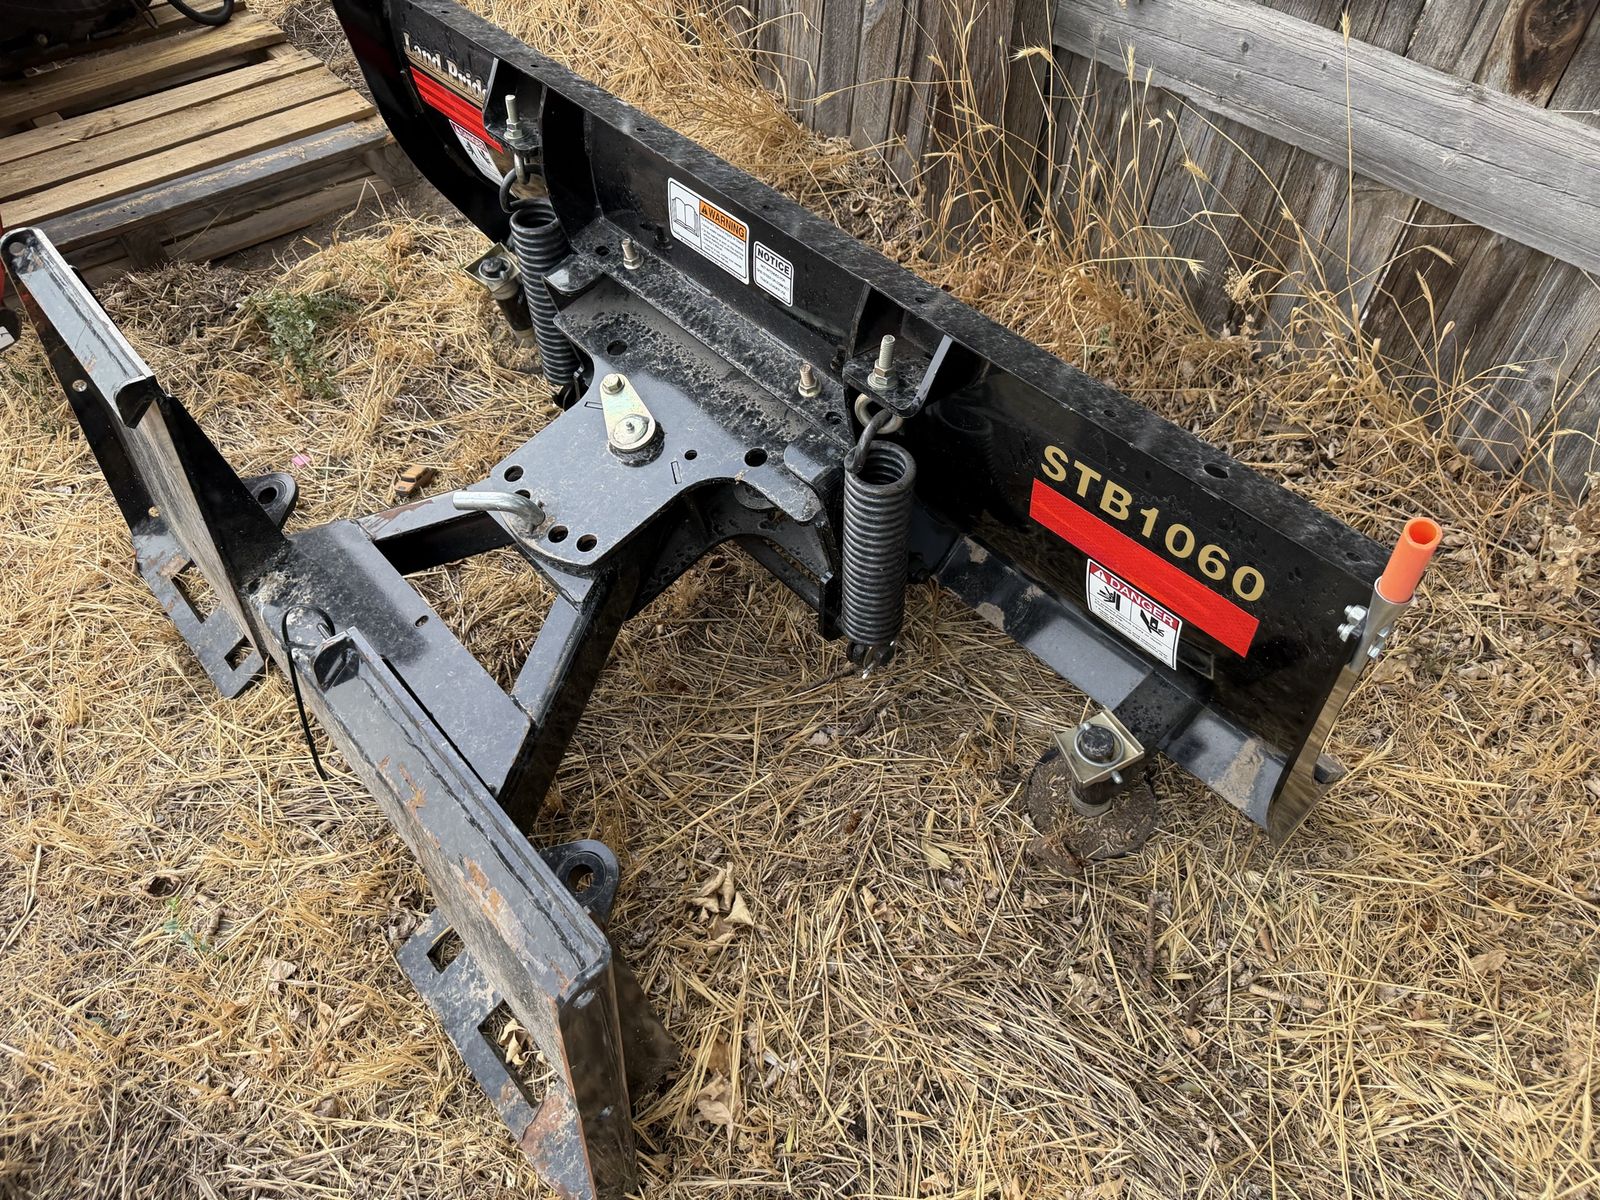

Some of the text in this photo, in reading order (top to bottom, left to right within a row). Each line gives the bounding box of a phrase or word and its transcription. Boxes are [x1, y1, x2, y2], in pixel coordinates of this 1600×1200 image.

[403, 32, 442, 74] Land
[708, 207, 745, 238] WARNING
[757, 247, 790, 276] NOTICE
[1041, 445, 1266, 602] STB1060
[1110, 577, 1174, 627] DANGER
